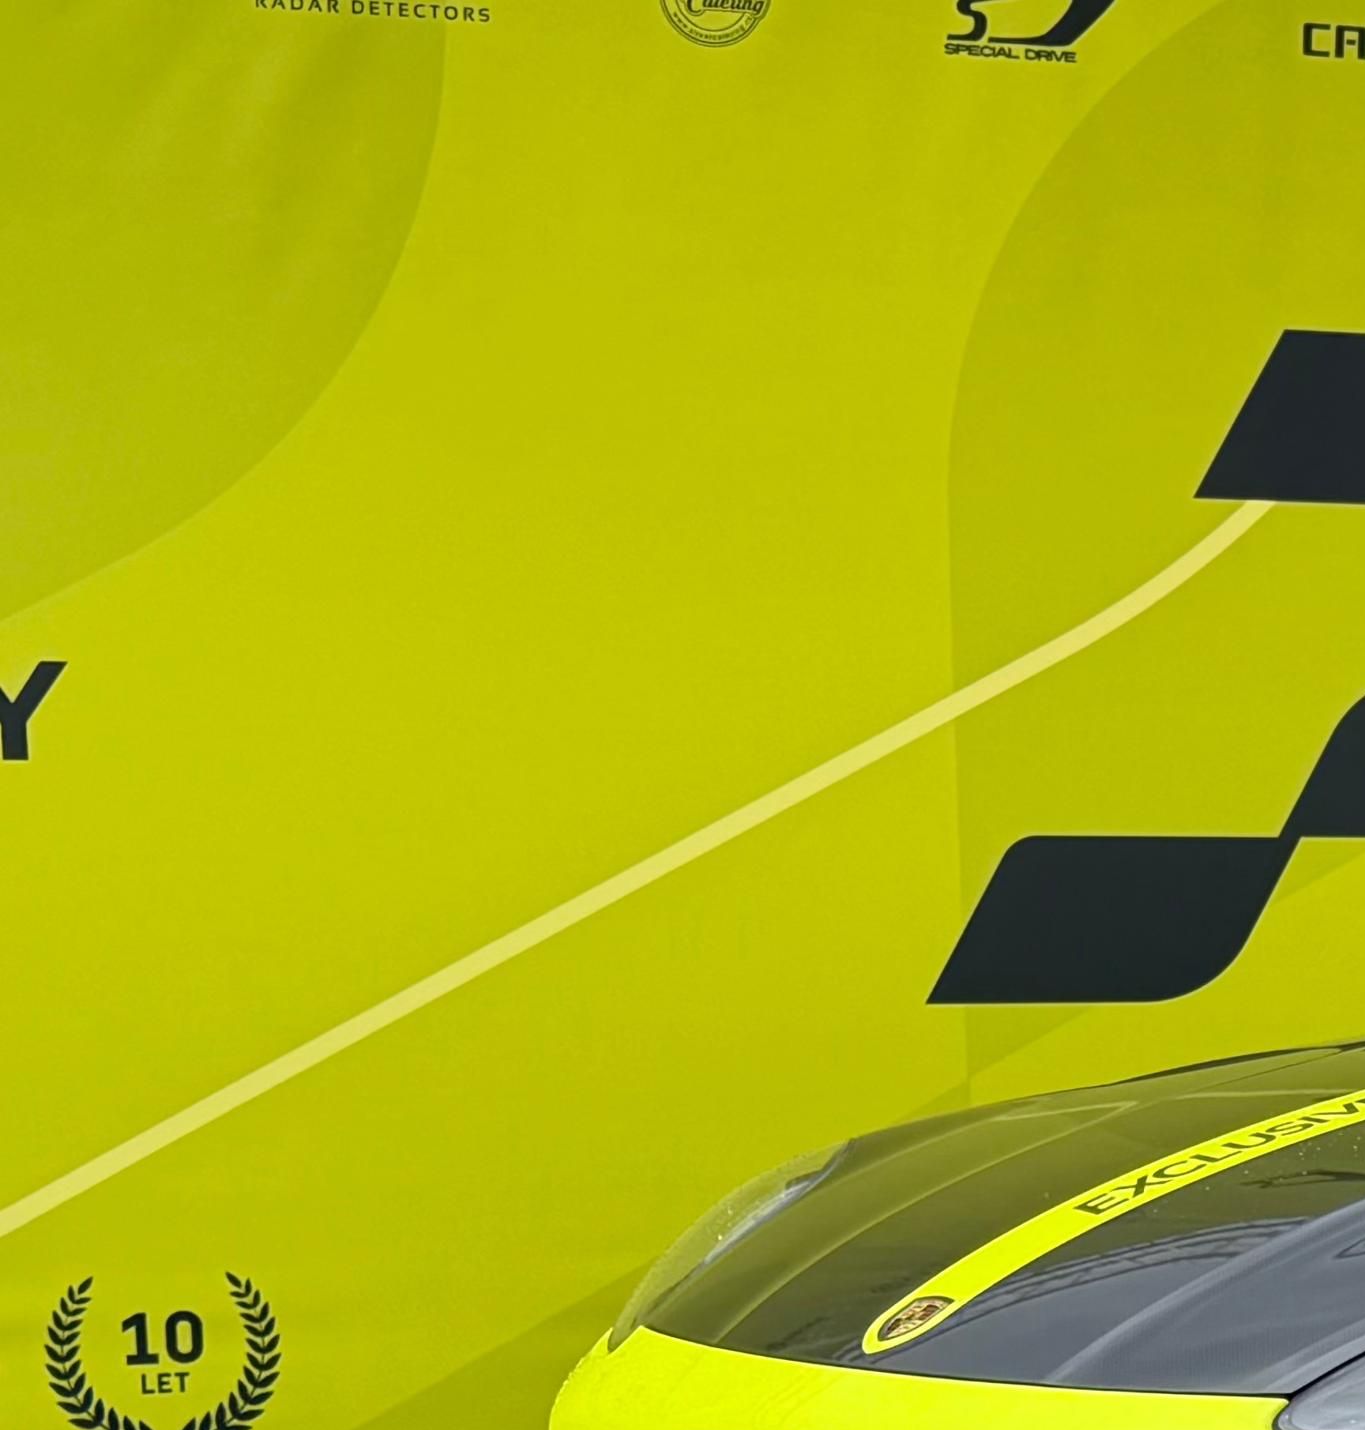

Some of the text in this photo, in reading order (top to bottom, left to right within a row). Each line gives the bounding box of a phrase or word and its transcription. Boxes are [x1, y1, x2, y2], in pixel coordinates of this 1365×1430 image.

[351, 0, 490, 22] DETECTORS
[944, 43, 1077, 64] SPECIAL DRIVE
[121, 1310, 204, 1366] 10
[140, 1371, 190, 1396] LET
